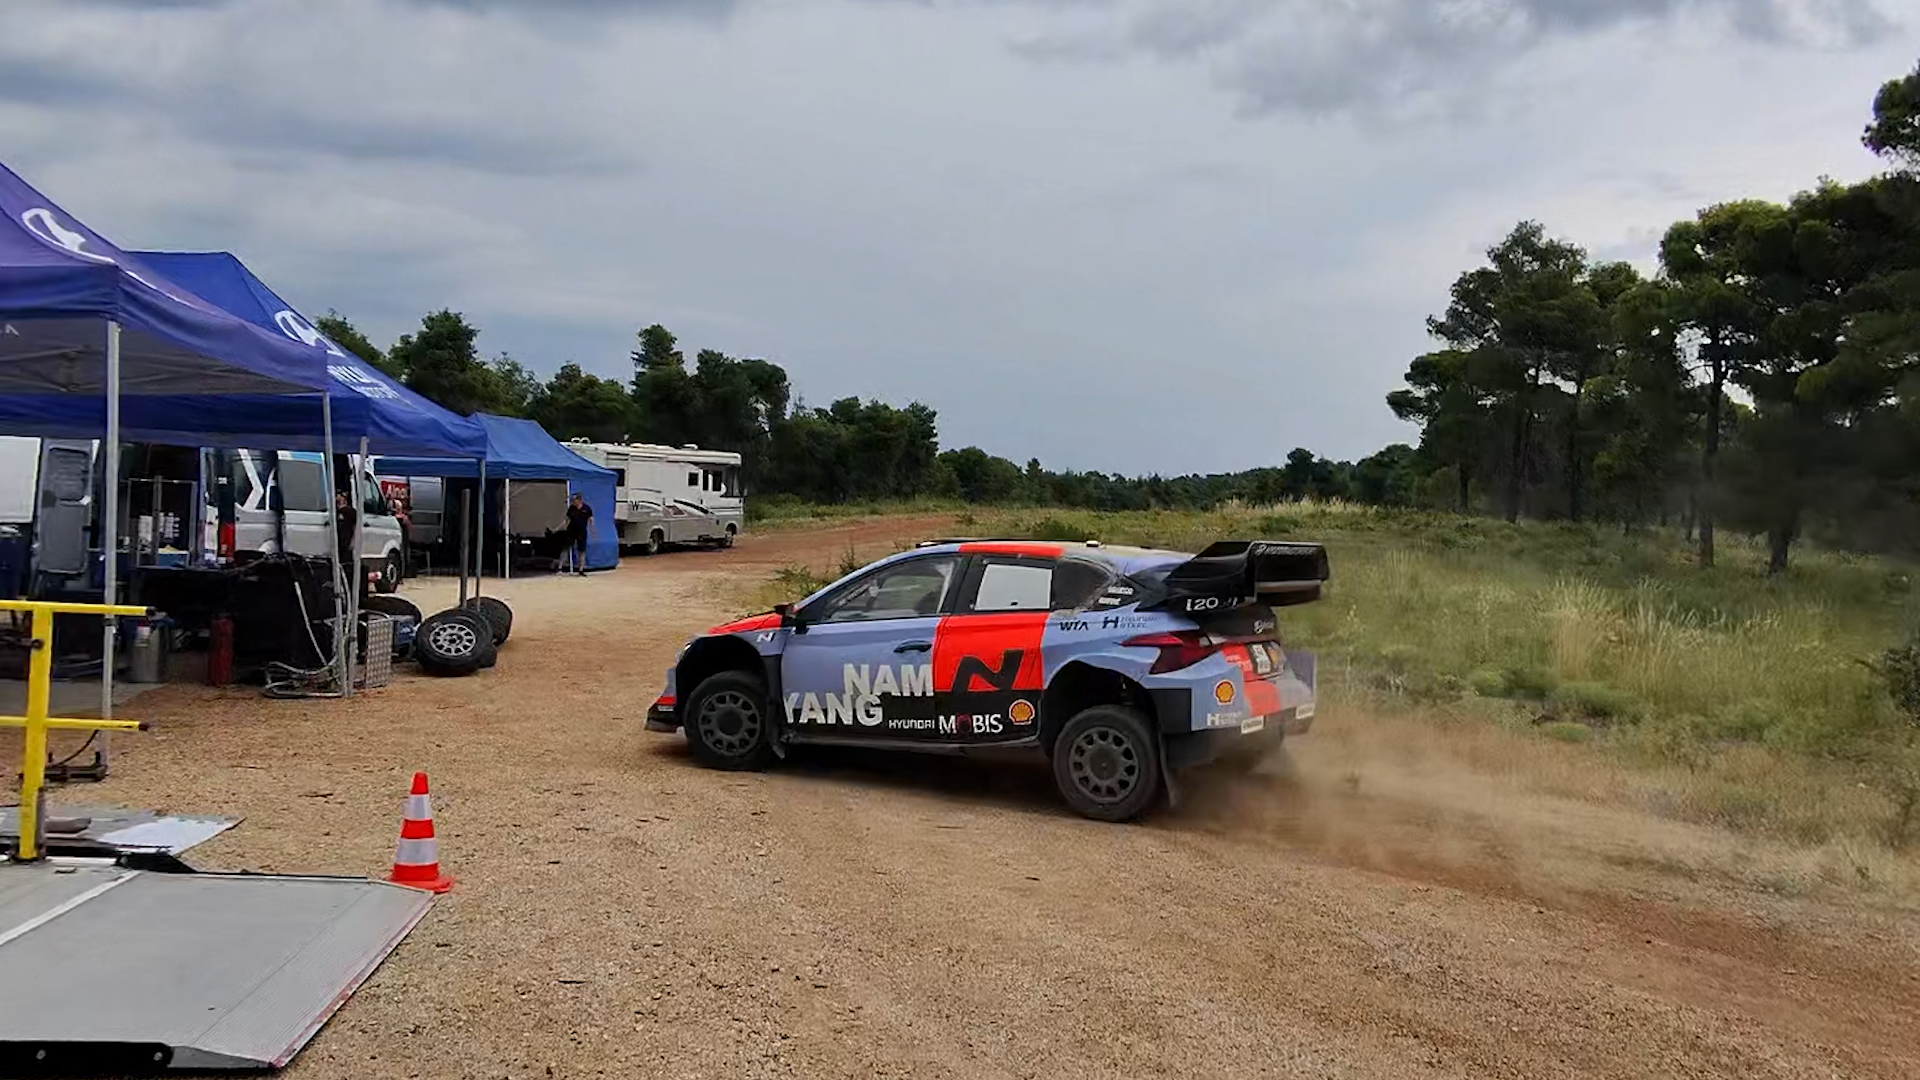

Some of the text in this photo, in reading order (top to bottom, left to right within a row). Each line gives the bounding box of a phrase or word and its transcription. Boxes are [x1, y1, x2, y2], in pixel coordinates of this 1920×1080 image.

[843, 663, 934, 697] NAM
[783, 692, 883, 726] YANG
[888, 718, 935, 730] HYUNDAI
[938, 713, 1003, 735] MOBIS
